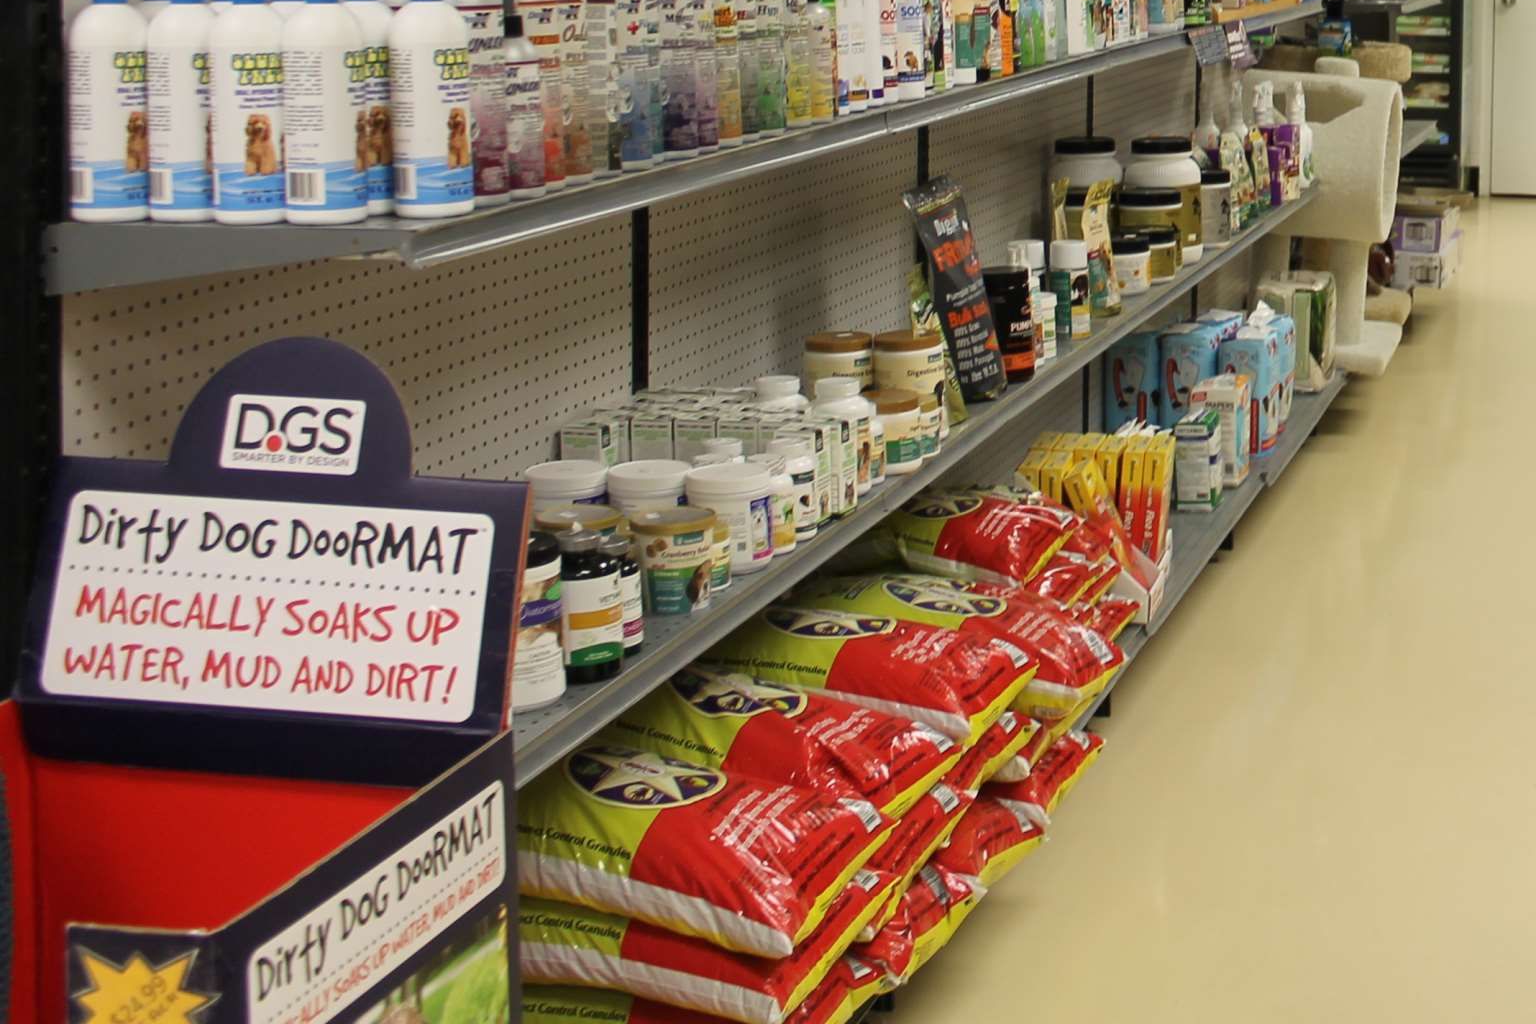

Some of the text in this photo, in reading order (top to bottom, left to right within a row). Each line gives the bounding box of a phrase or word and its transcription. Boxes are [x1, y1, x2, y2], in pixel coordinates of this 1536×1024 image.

[78, 503, 189, 564] Dirty
[74, 584, 275, 637] MAGICALLY
[406, 607, 461, 647] UP
[63, 643, 460, 706] WATER, MUD AND DIRT!
[751, 658, 786, 670] Control
[786, 661, 828, 675] Granules
[545, 826, 586, 848] Control
[586, 836, 632, 861] Granules
[255, 918, 333, 1002] Dirty
